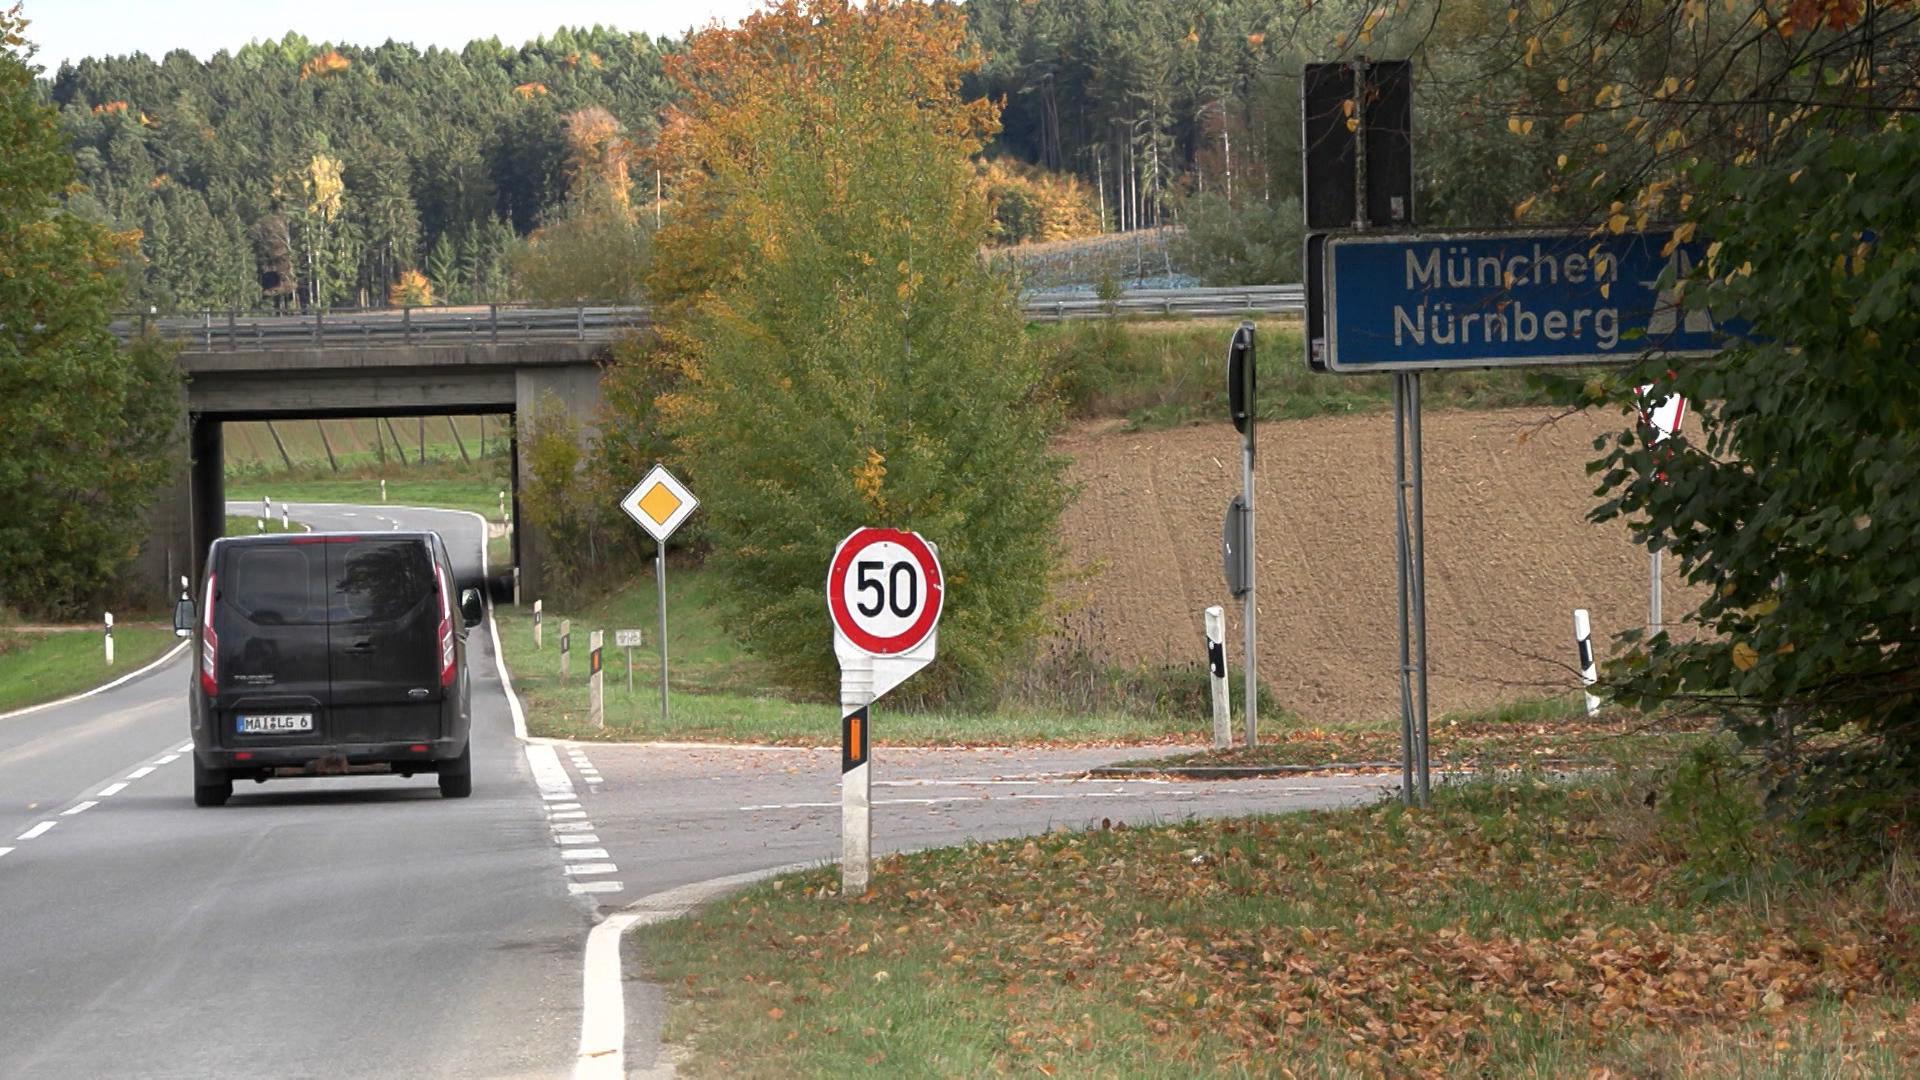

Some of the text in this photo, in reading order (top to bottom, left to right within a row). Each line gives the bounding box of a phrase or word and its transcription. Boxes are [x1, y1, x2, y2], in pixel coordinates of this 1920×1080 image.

[1406, 243, 1618, 290] München
[1394, 301, 1619, 349] Nürnberg
[857, 561, 917, 618] 50
